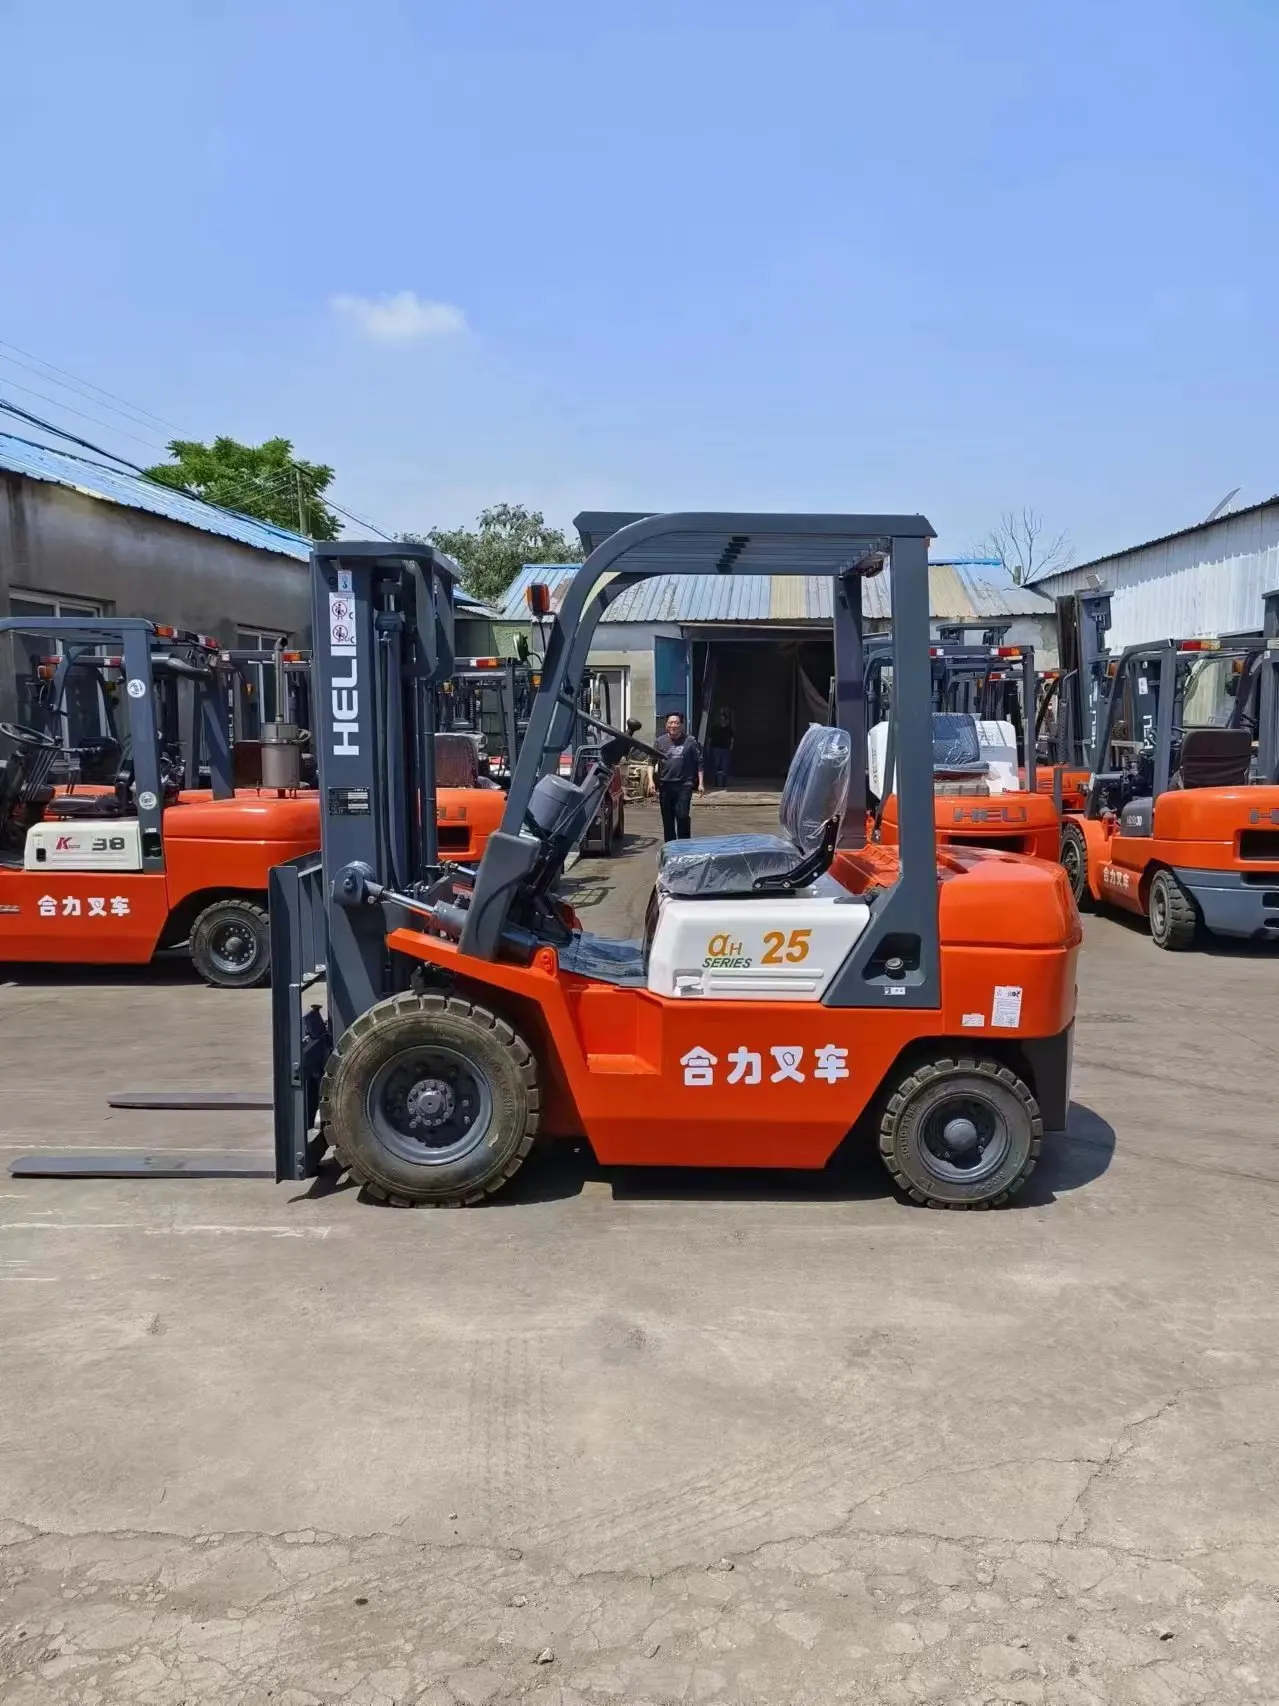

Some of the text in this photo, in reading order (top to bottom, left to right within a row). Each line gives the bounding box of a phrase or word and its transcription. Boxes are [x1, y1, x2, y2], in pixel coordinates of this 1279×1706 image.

[331, 645, 360, 756] HELI
[952, 807, 1027, 822] HELI
[92, 837, 126, 851] 38
[37, 894, 131, 917] 合力叉车
[760, 929, 813, 965] 25
[702, 957, 753, 969] SERIES
[679, 1043, 850, 1086] 合力叉车
